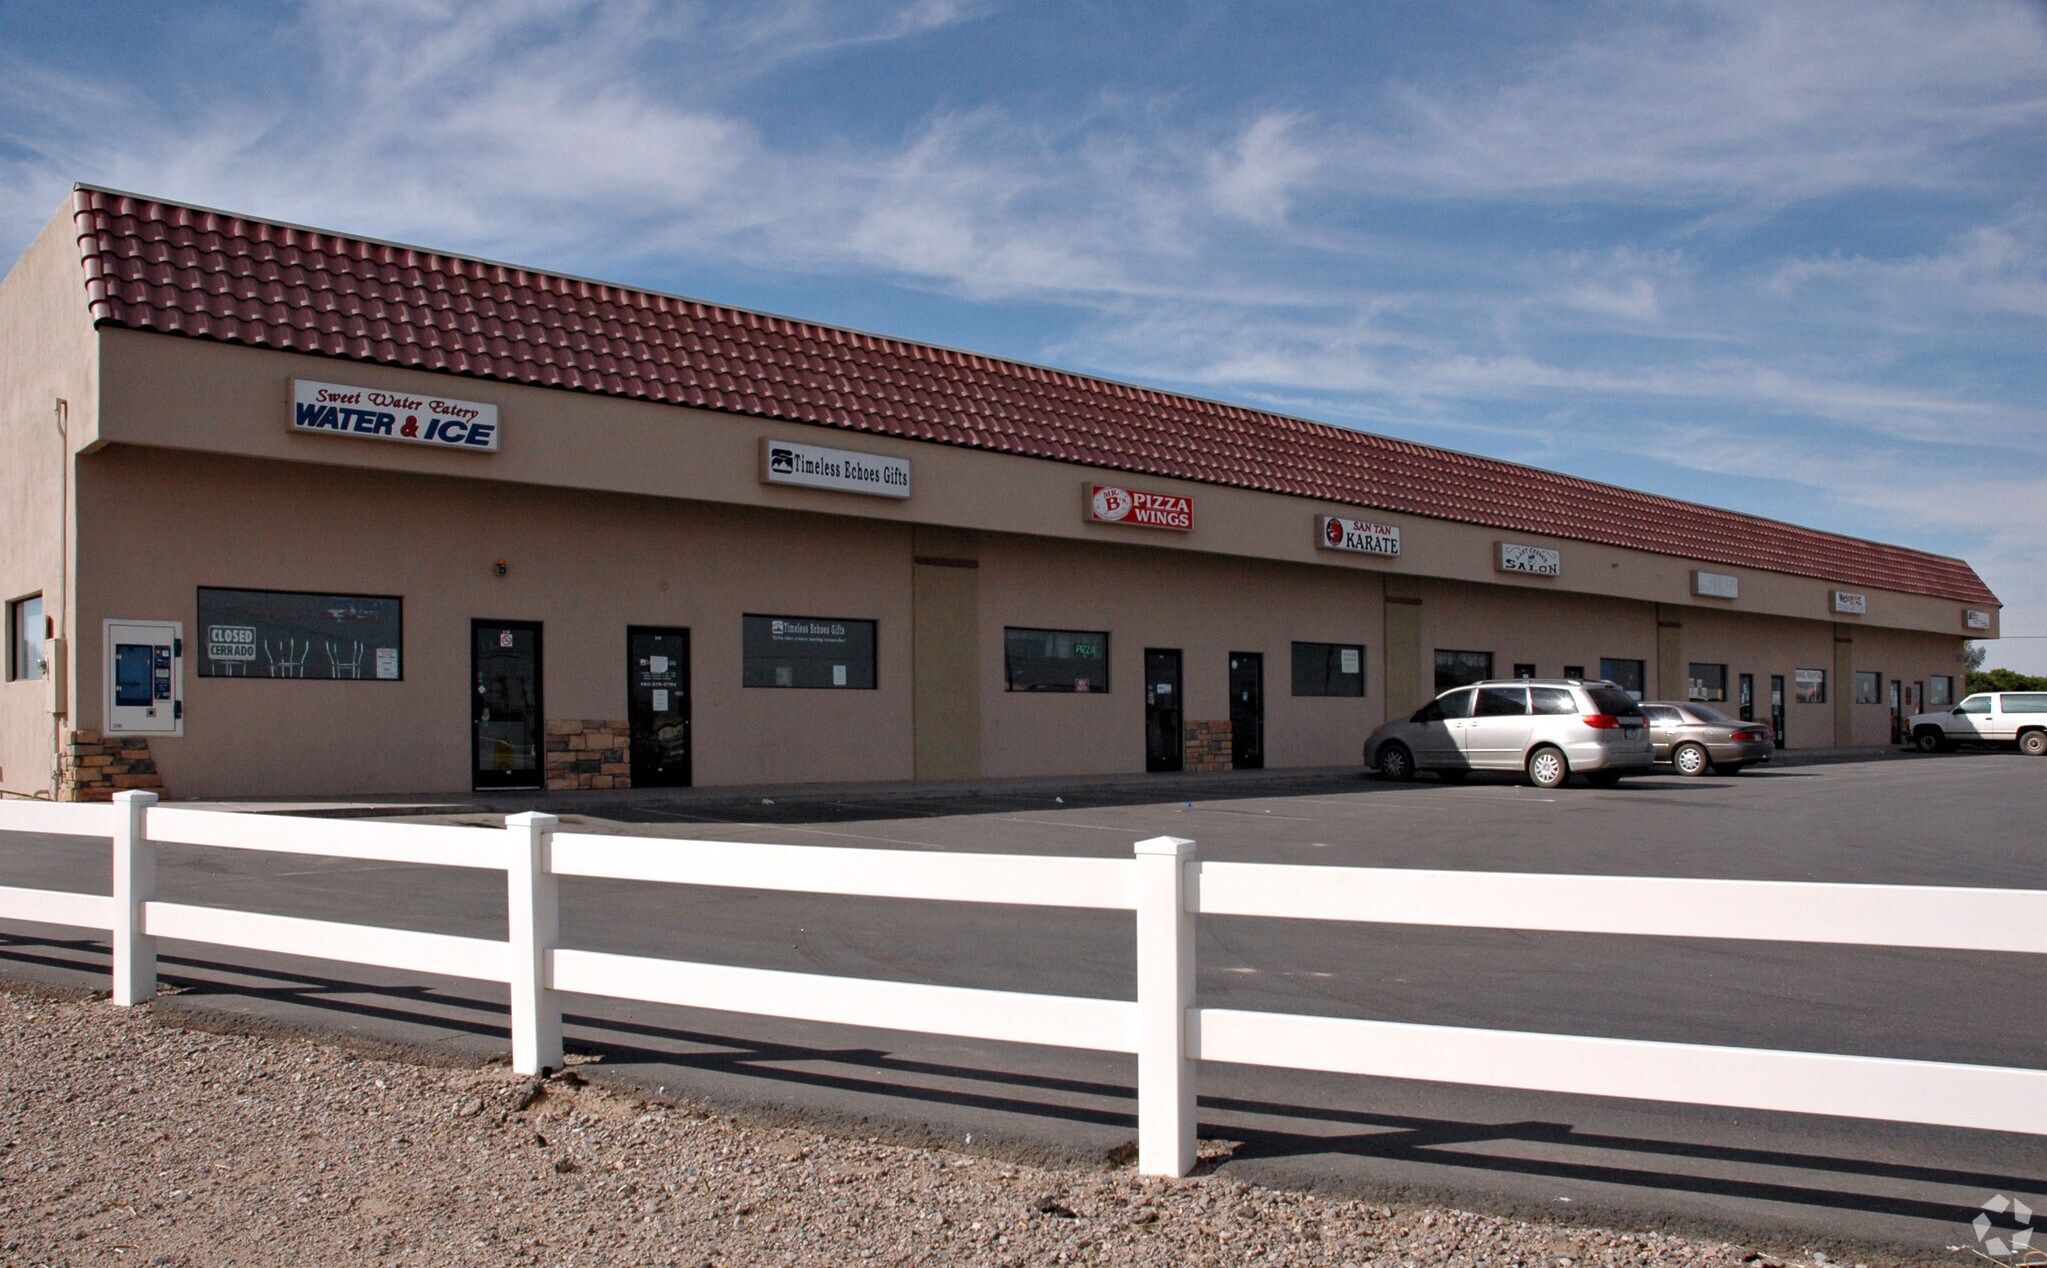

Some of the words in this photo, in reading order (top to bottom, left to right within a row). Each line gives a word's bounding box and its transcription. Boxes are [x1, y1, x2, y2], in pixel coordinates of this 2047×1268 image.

[316, 389, 361, 405] Sweet
[368, 392, 423, 411] Water
[429, 400, 479, 423] Eatery
[296, 402, 395, 436] WATER
[400, 415, 419, 438] &
[424, 418, 495, 446] ICE
[794, 454, 840, 477] Timeless
[844, 461, 880, 483] Echoes
[884, 466, 908, 486] Gifts
[1133, 493, 1190, 513] PIZZA
[1134, 509, 1189, 527] WINGS
[1353, 521, 1371, 532] SAN
[1374, 525, 1392, 535] TAN
[1346, 532, 1398, 554] KARATE
[1505, 559, 1557, 574] SALON
[212, 629, 253, 643] CLOSED
[784, 622, 808, 634] Timeless
[810, 623, 830, 635] Echoes
[831, 624, 845, 636] Gifts
[211, 645, 254, 657] CERRADO
[1076, 644, 1096, 655] PIZZA
